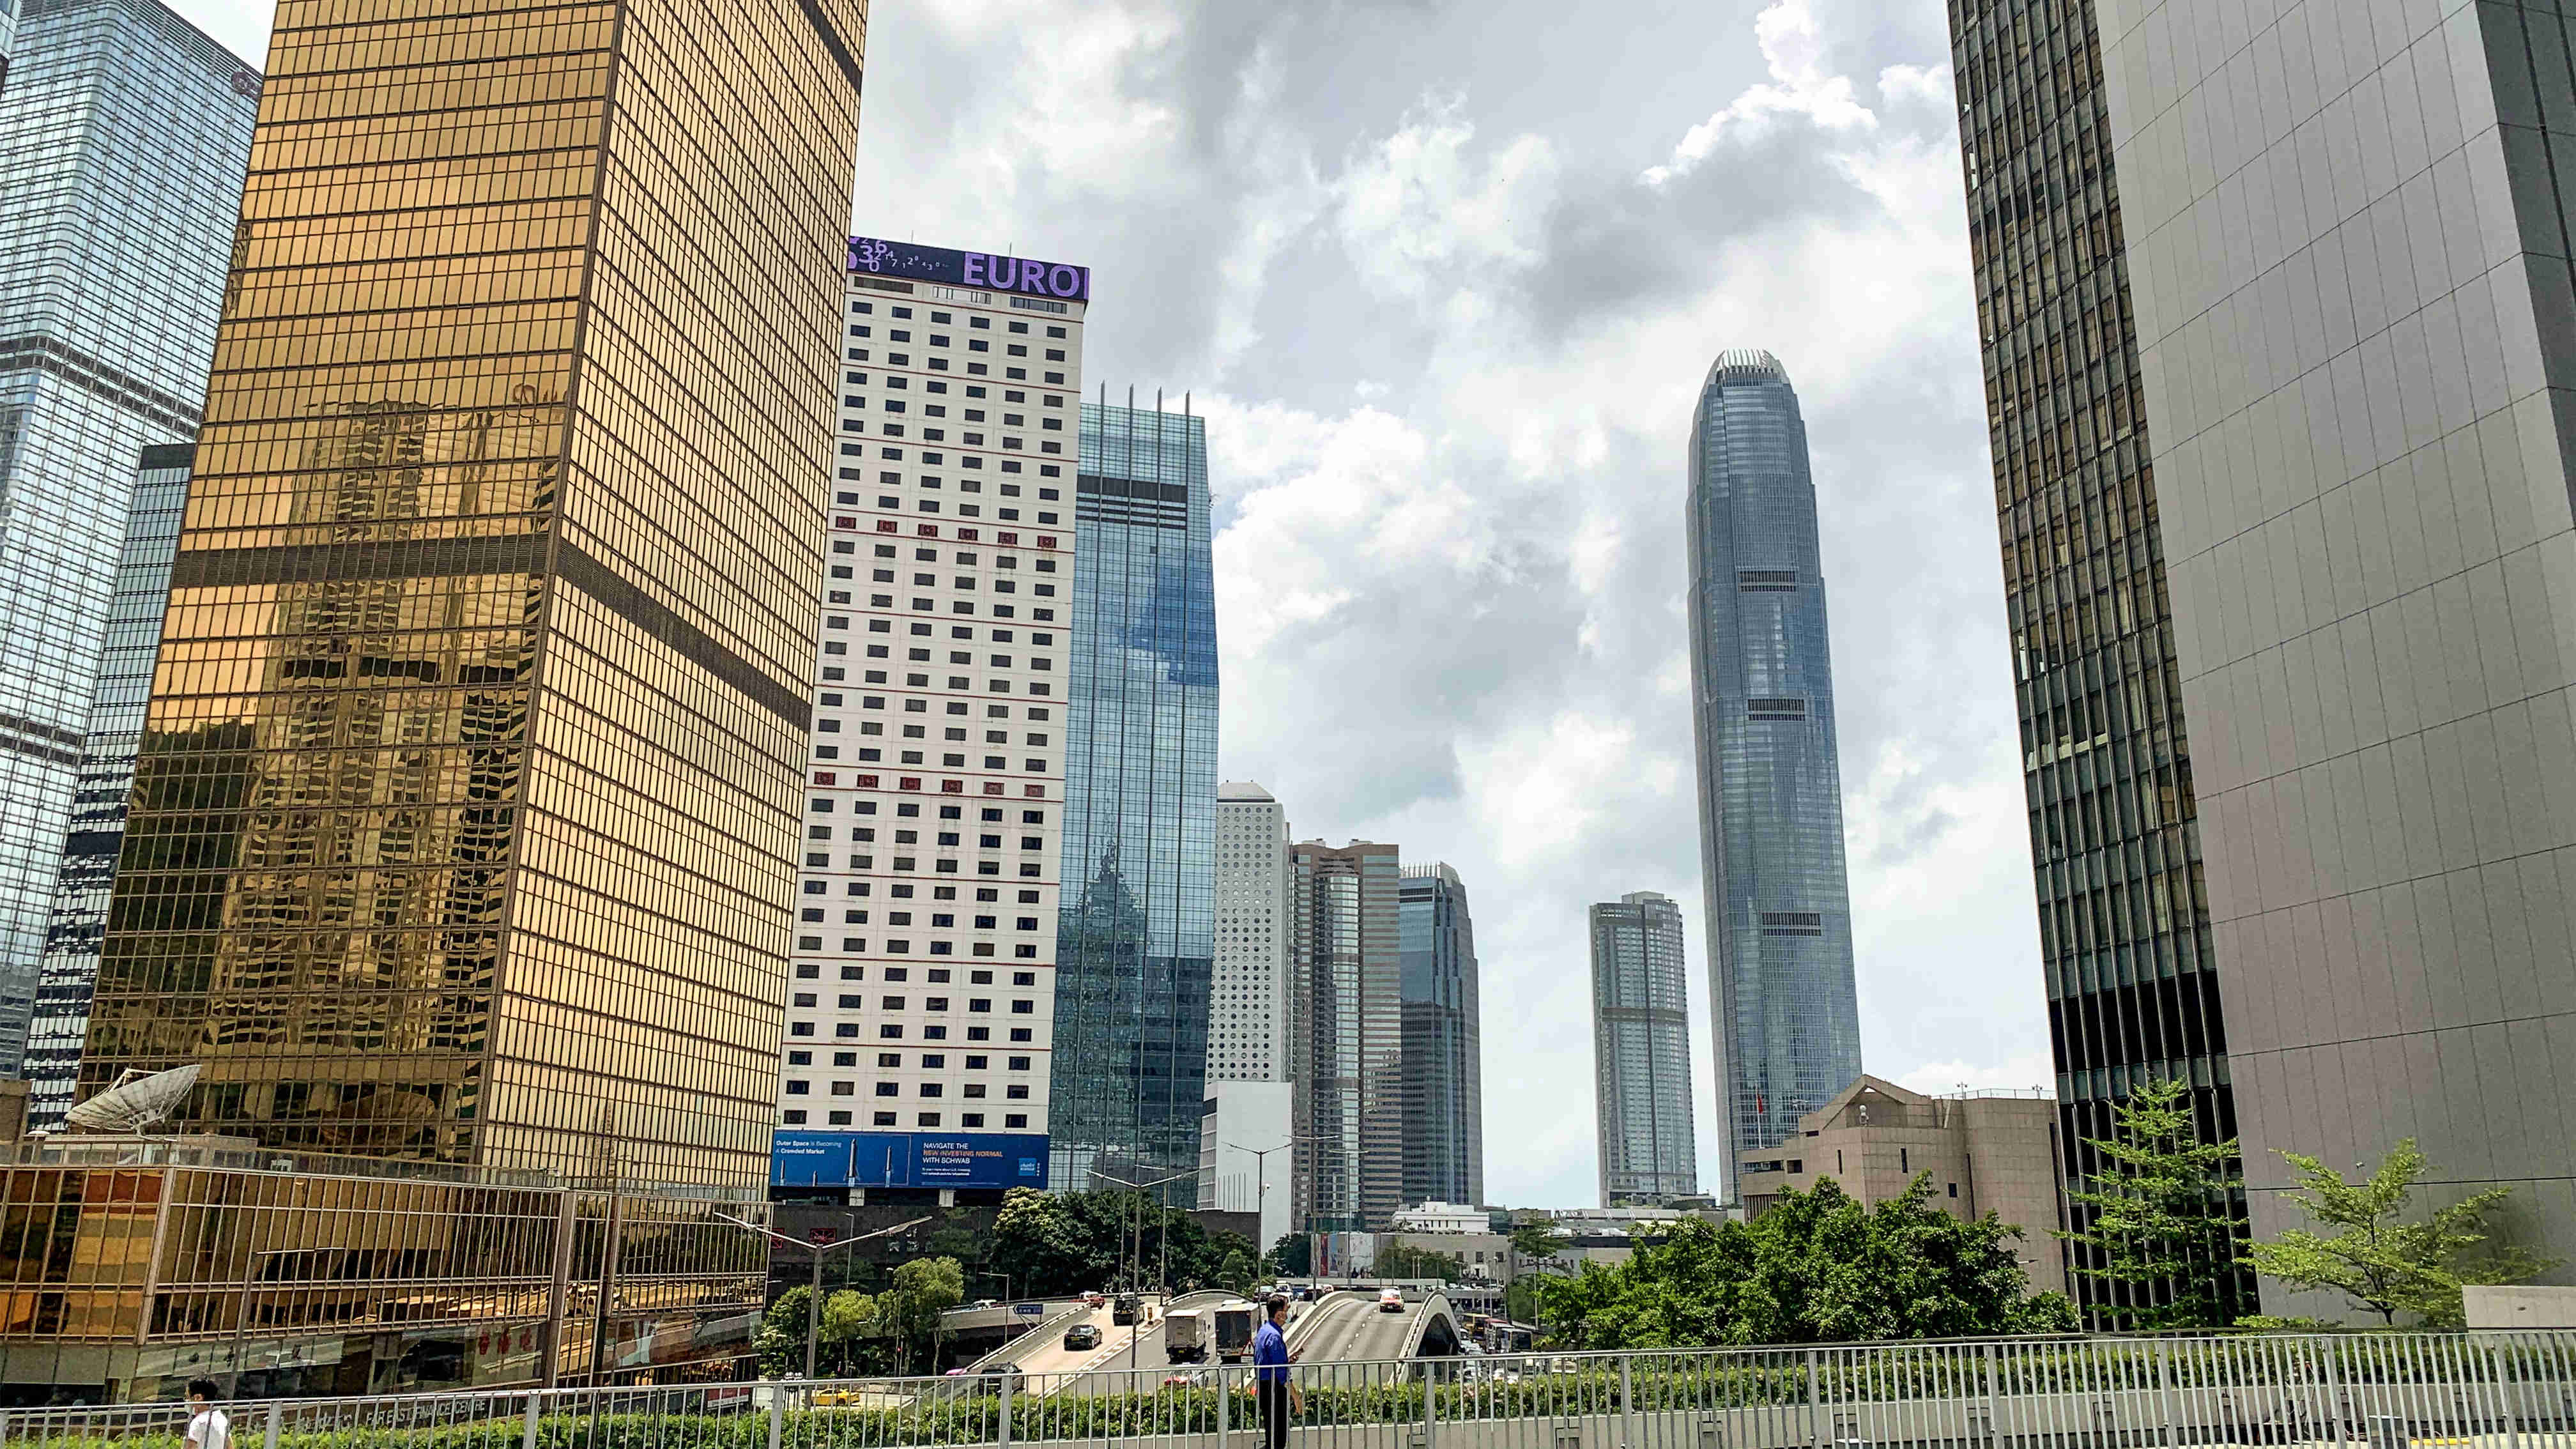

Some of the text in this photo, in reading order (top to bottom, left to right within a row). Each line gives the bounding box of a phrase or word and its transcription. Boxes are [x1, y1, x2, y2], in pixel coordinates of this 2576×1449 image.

[859, 245, 873, 263] 3
[963, 252, 1080, 297] EURO
[365, 1411, 385, 1425] FR
[387, 1407, 413, 1423] EST
[454, 1399, 486, 1414] CENRE
